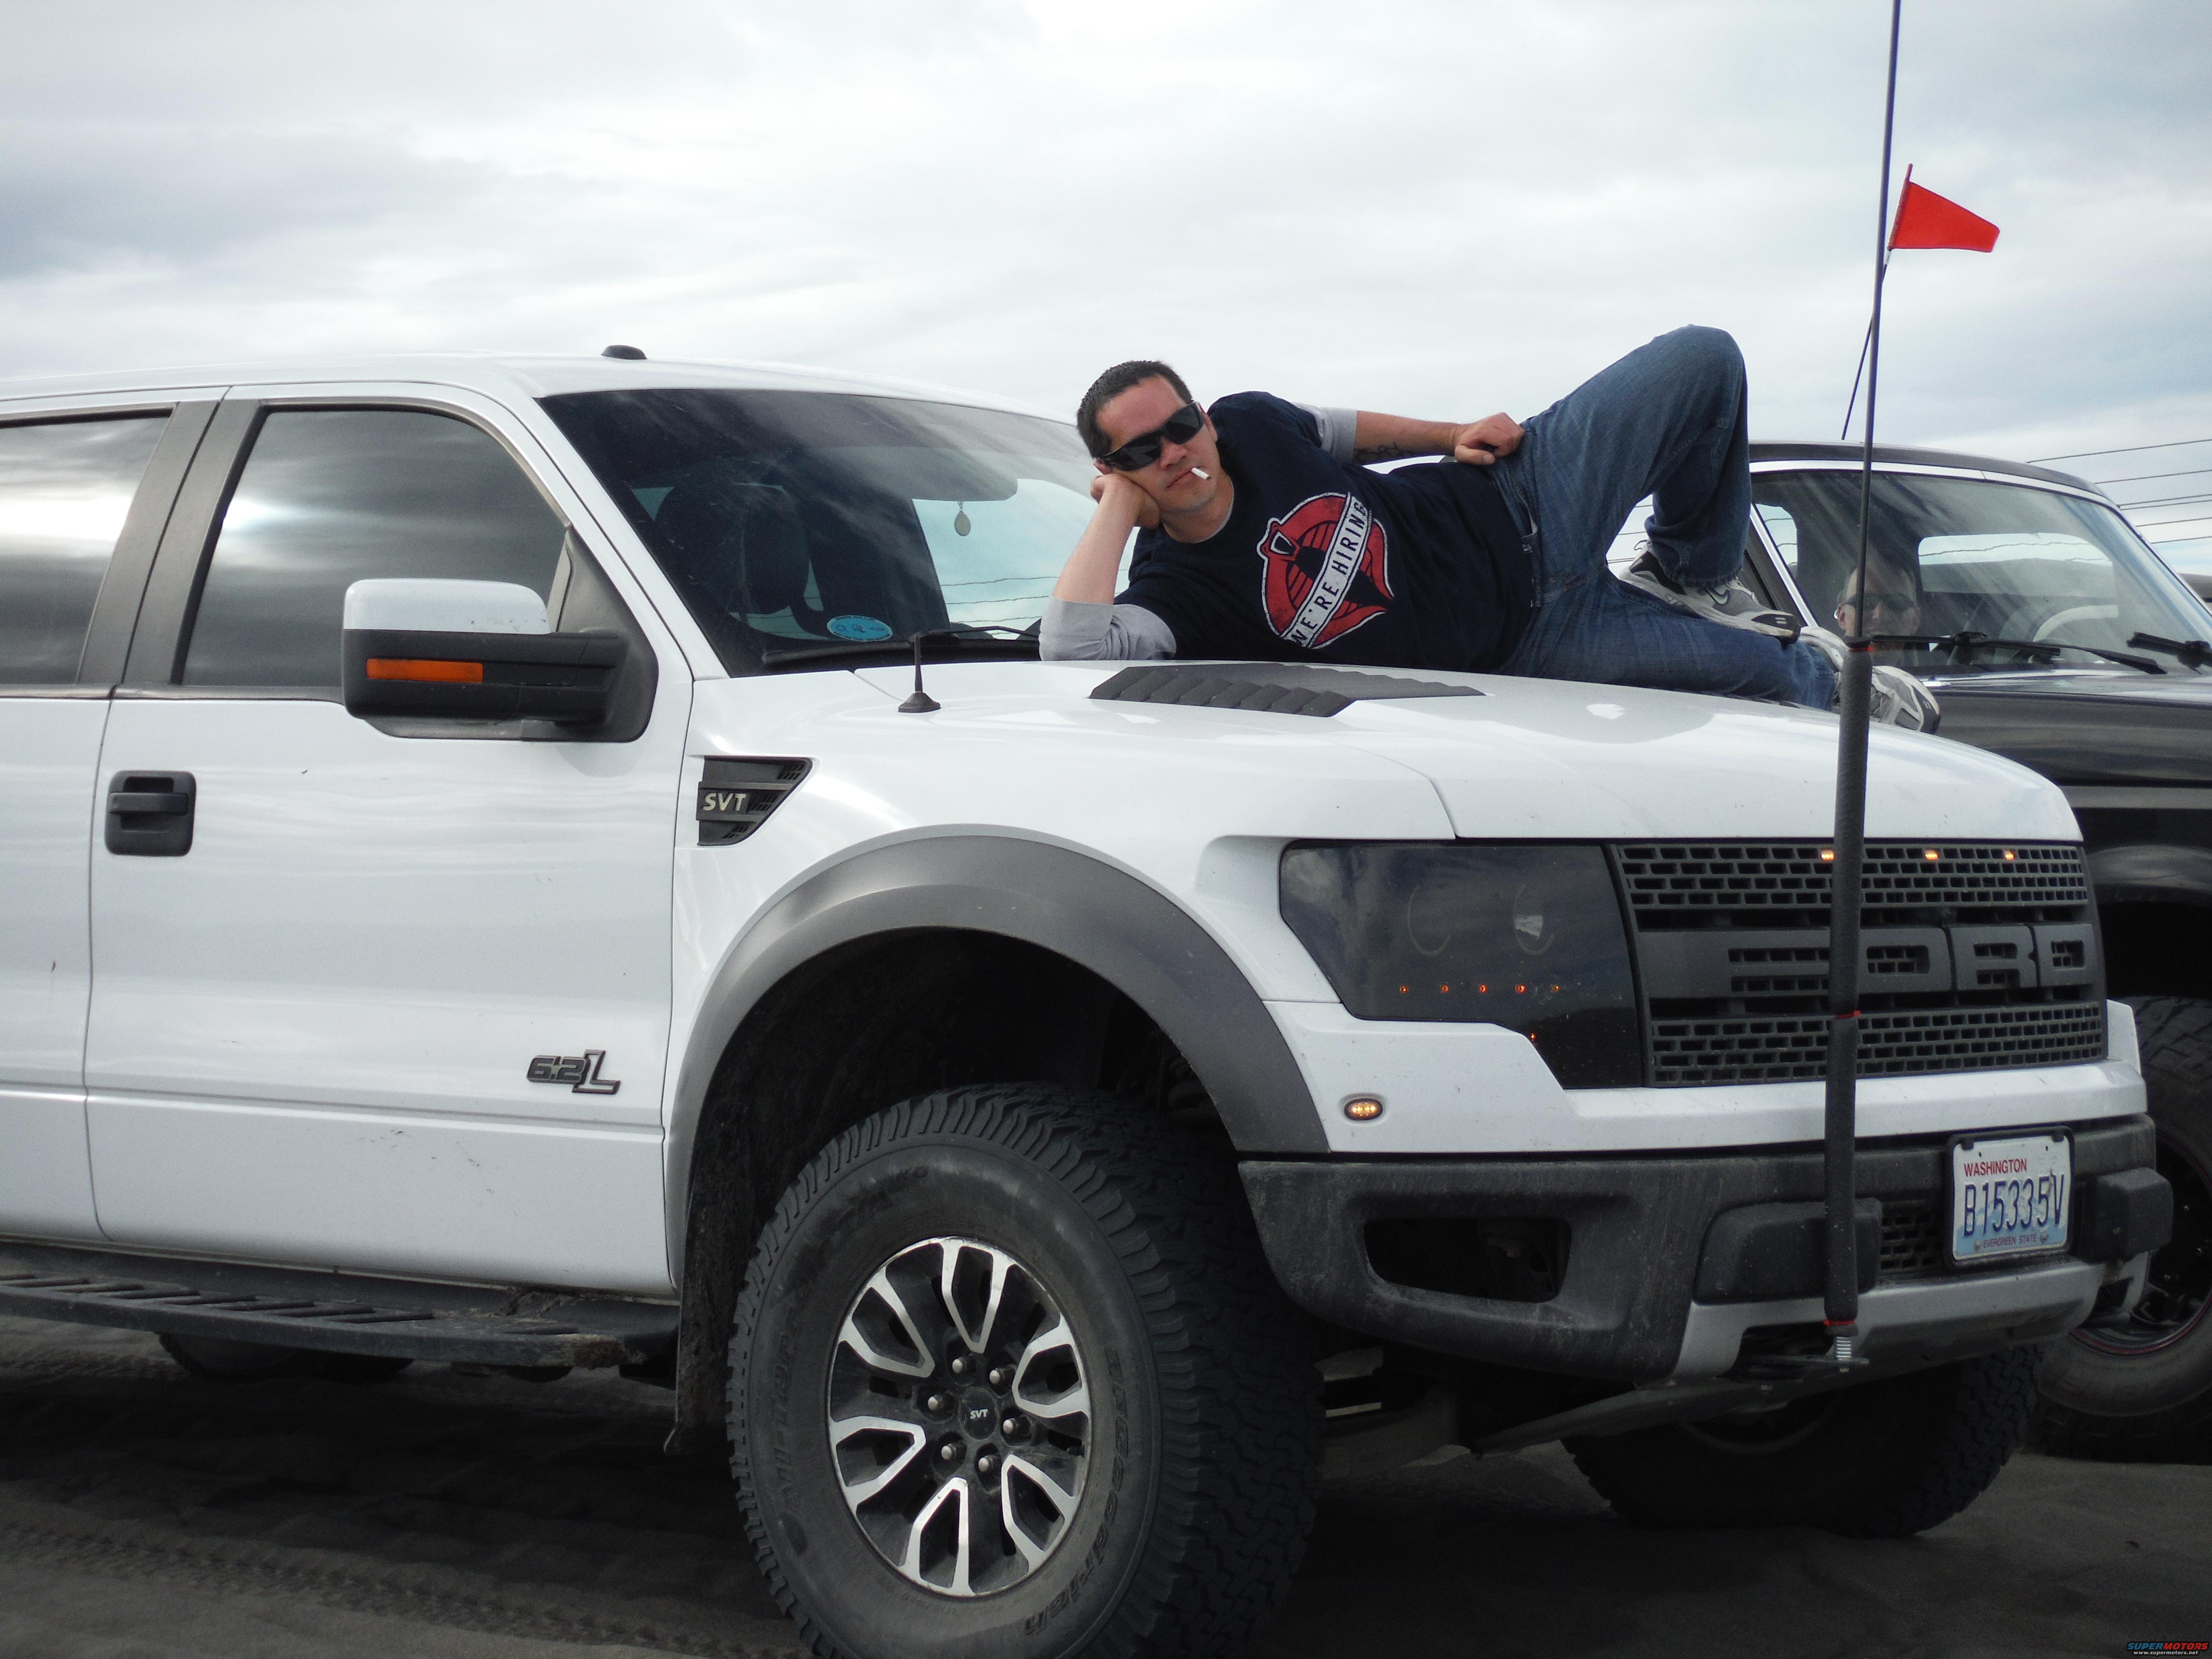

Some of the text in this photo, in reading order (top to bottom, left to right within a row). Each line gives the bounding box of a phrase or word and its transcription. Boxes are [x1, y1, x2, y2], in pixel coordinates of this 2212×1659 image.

[1331, 501, 1366, 576] HIRING
[703, 793, 746, 811] SVT
[1964, 1158, 2027, 1177] WASHINGTON
[1964, 1174, 2064, 1237] B15335V
[1983, 1234, 2037, 1249] EVERGREEN STATE
[970, 1409, 989, 1419] SVT
